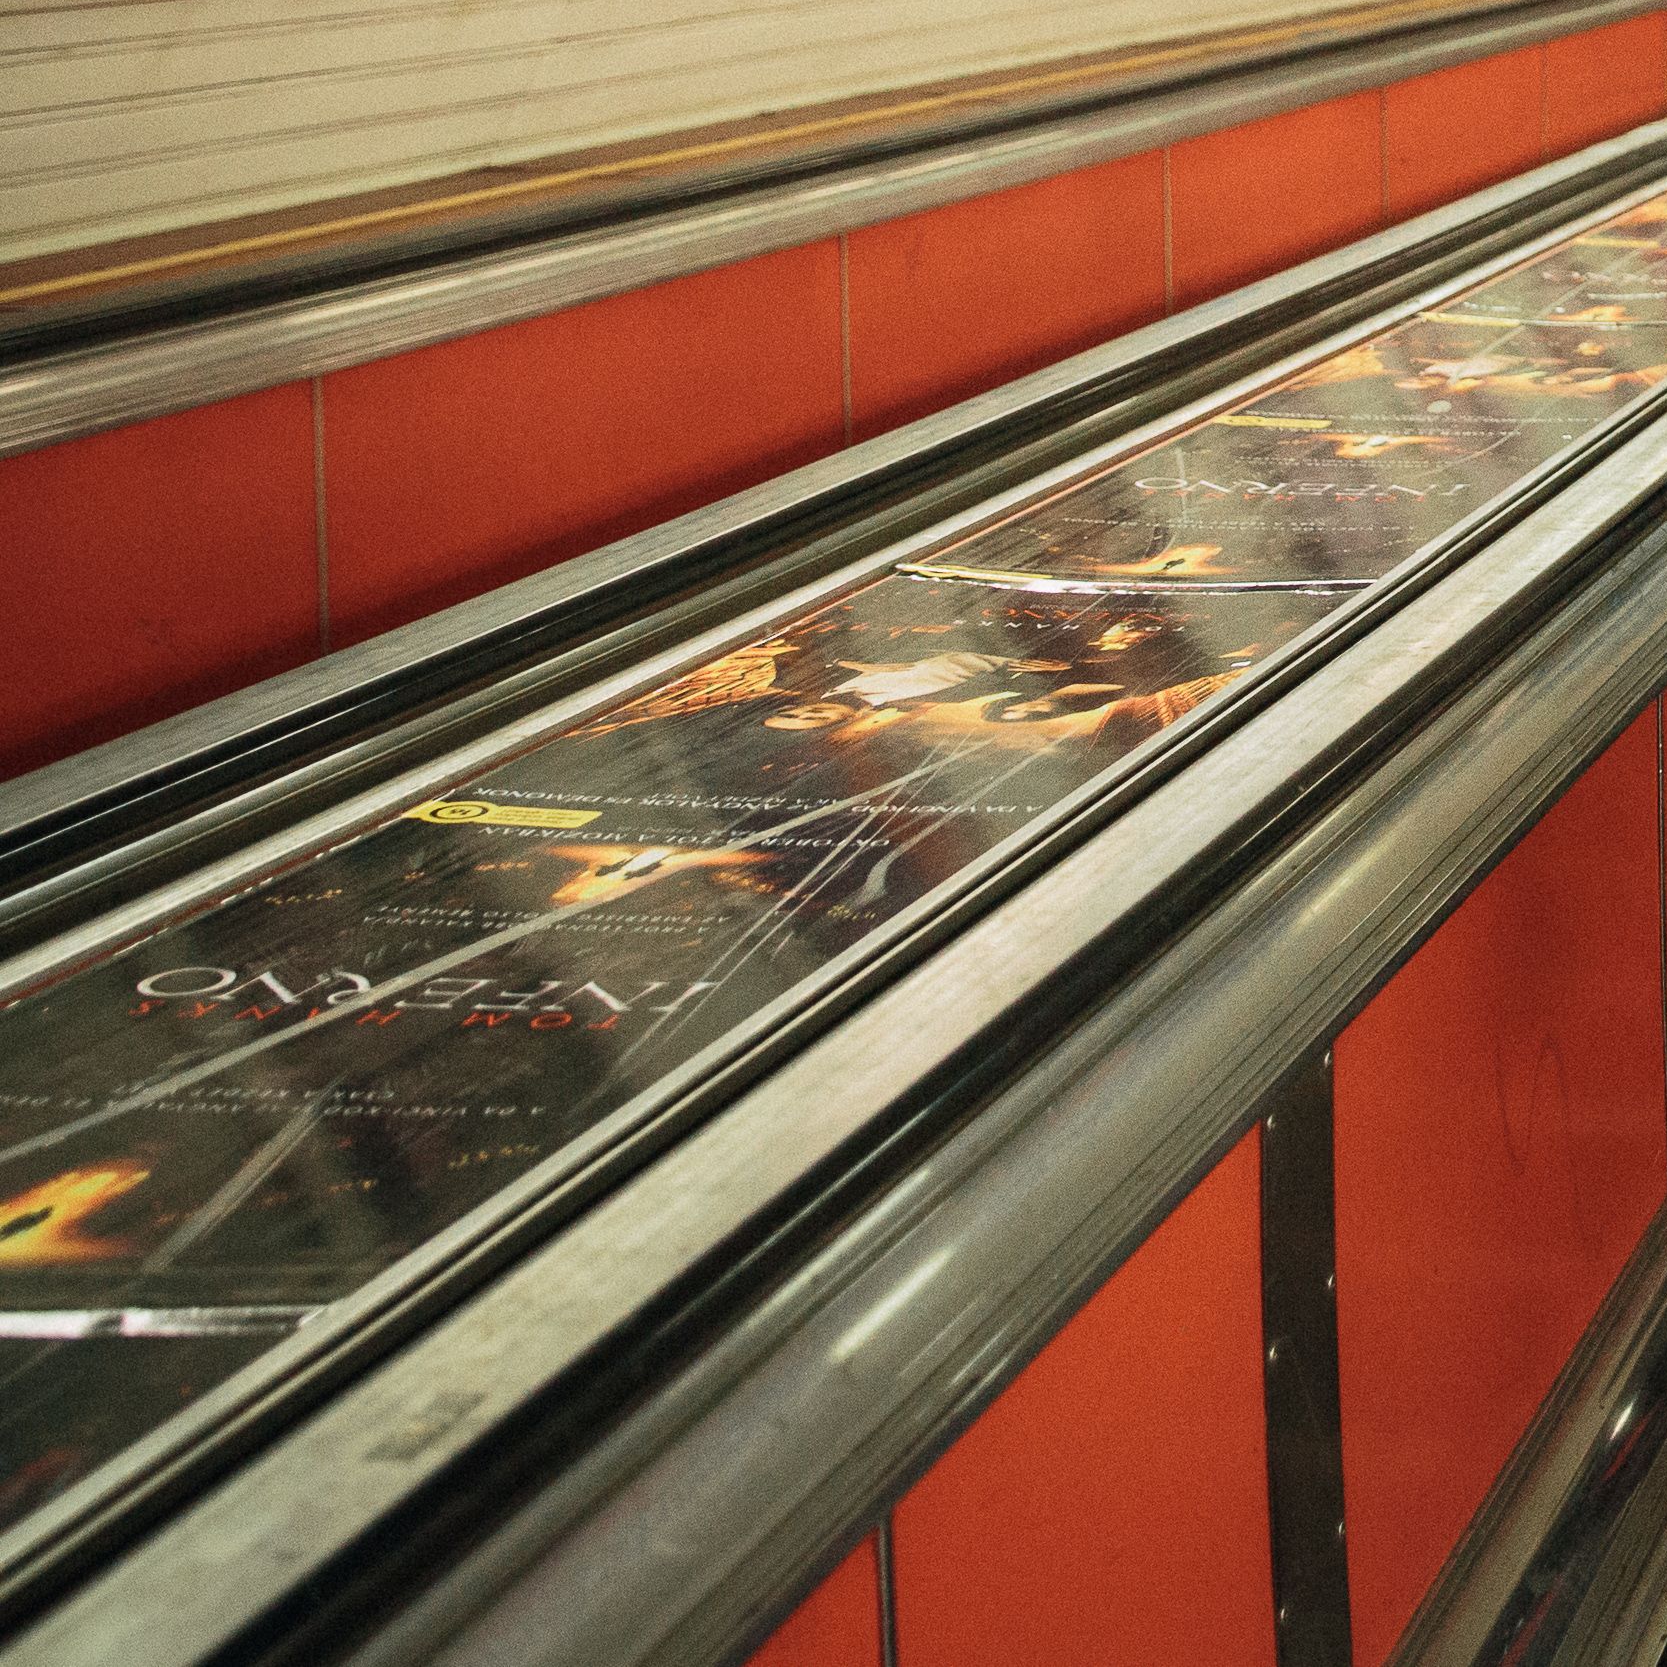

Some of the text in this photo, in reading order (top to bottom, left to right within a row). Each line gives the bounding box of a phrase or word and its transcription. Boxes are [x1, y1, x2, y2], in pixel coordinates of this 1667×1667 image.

[1134, 476, 1470, 497] INFERNO
[134, 965, 721, 1014] INFERNO
[127, 999, 402, 1028] HNKS
